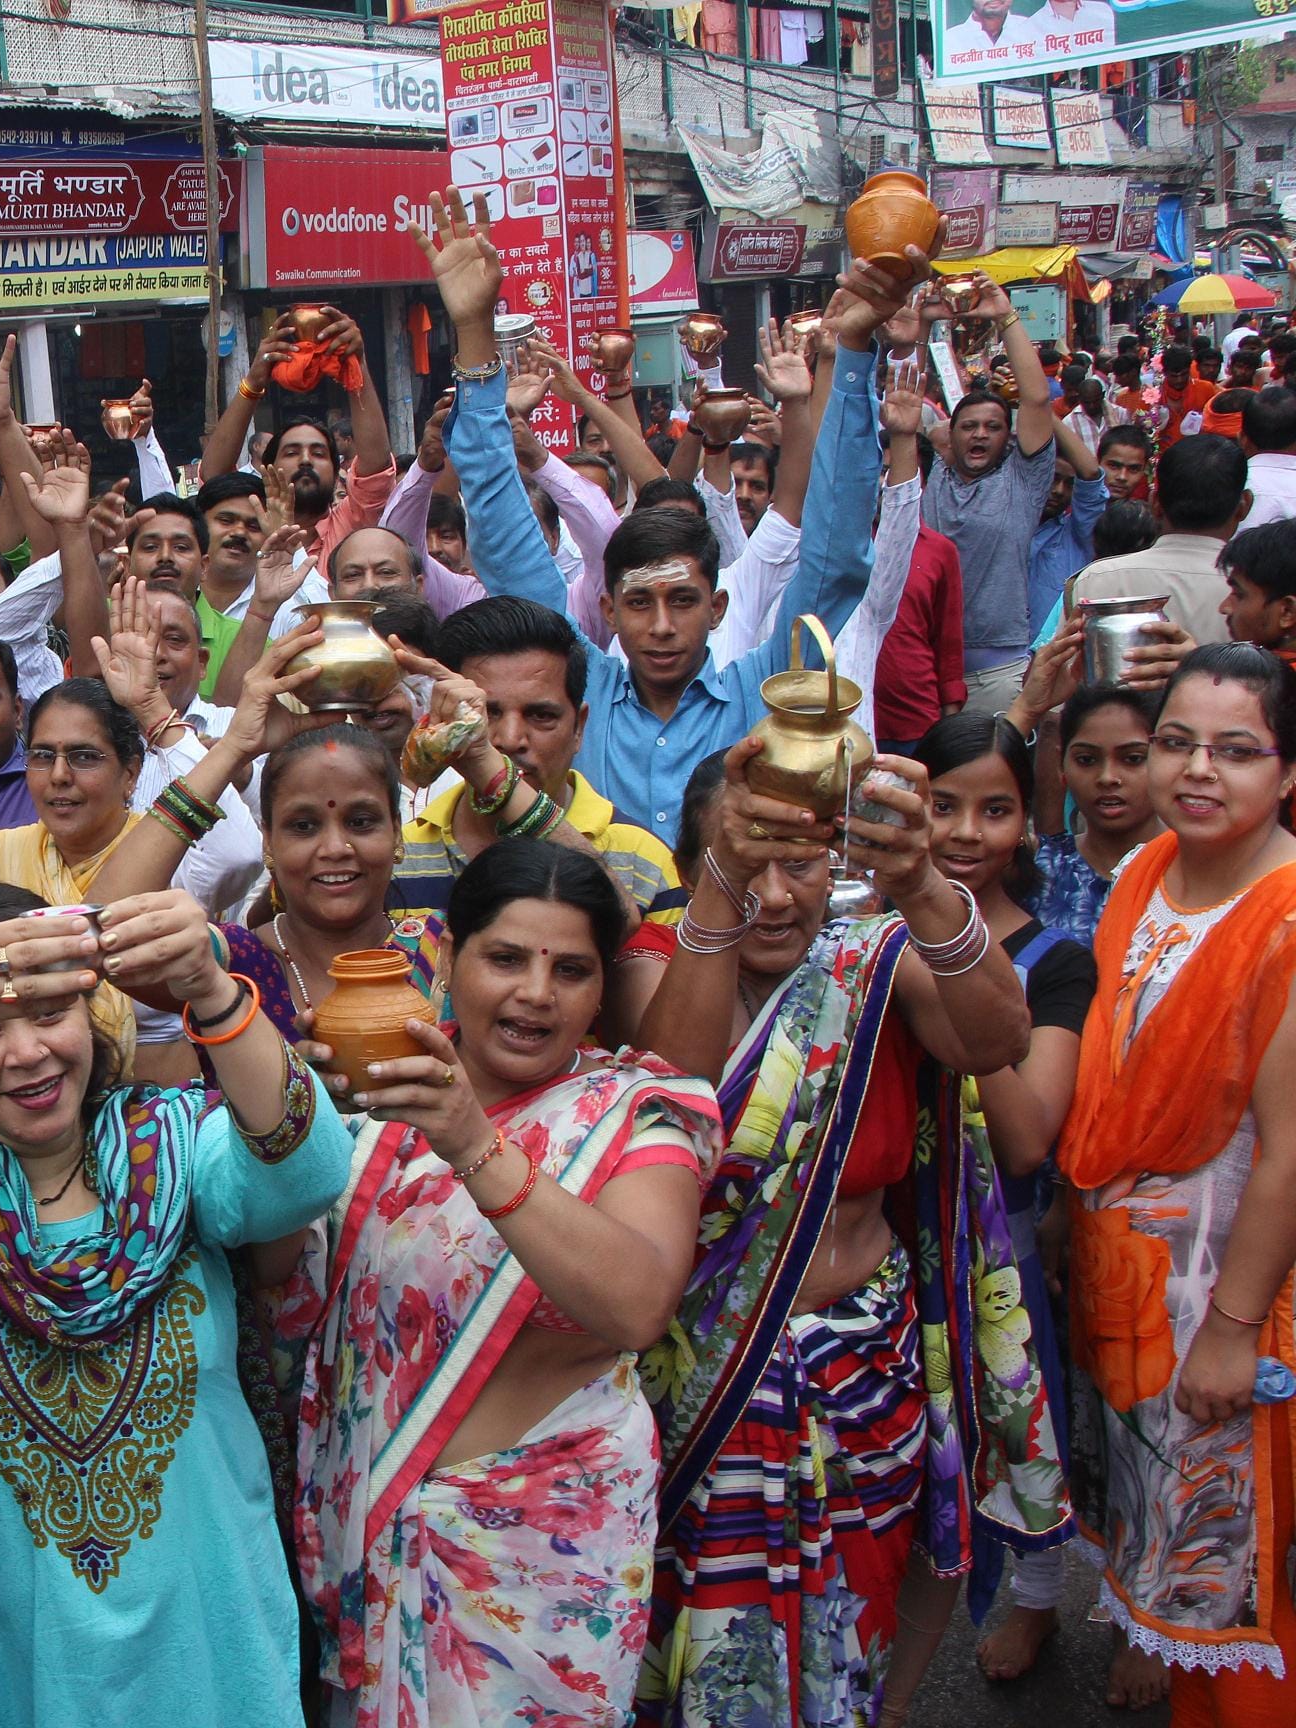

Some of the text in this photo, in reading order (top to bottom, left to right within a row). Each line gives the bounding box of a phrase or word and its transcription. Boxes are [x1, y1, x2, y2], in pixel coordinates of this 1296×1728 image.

[492, 35, 513, 54] सेवा
[515, 28, 548, 50] शिविर
[1074, 29, 1104, 46] यादव
[986, 46, 1008, 58] यादव
[478, 63, 500, 78] नगर
[502, 55, 532, 74] निगम
[54, 176, 128, 195] भण्डार
[182, 190, 208, 200] MARBL
[52, 202, 126, 219] BHANDAR
[171, 201, 186, 211] ARE
[188, 212, 206, 222] HERE
[302, 208, 388, 234] vodafone
[115, 236, 164, 266] (JAIPUR
[170, 234, 208, 264] WALE)
[509, 247, 522, 258] का
[525, 242, 549, 256] सबसे
[276, 266, 361, 282] Sawaika Communication
[513, 256, 563, 276] लोन देते हैं
[2, 278, 33, 298] मिलती
[52, 276, 67, 296] एवं
[68, 274, 91, 294] आर्डर
[93, 274, 108, 292] देने
[109, 278, 122, 292] पर
[122, 272, 134, 291] भी
[136, 271, 157, 290] तैयार
[158, 271, 179, 290] किया
[181, 275, 201, 289] जाता
